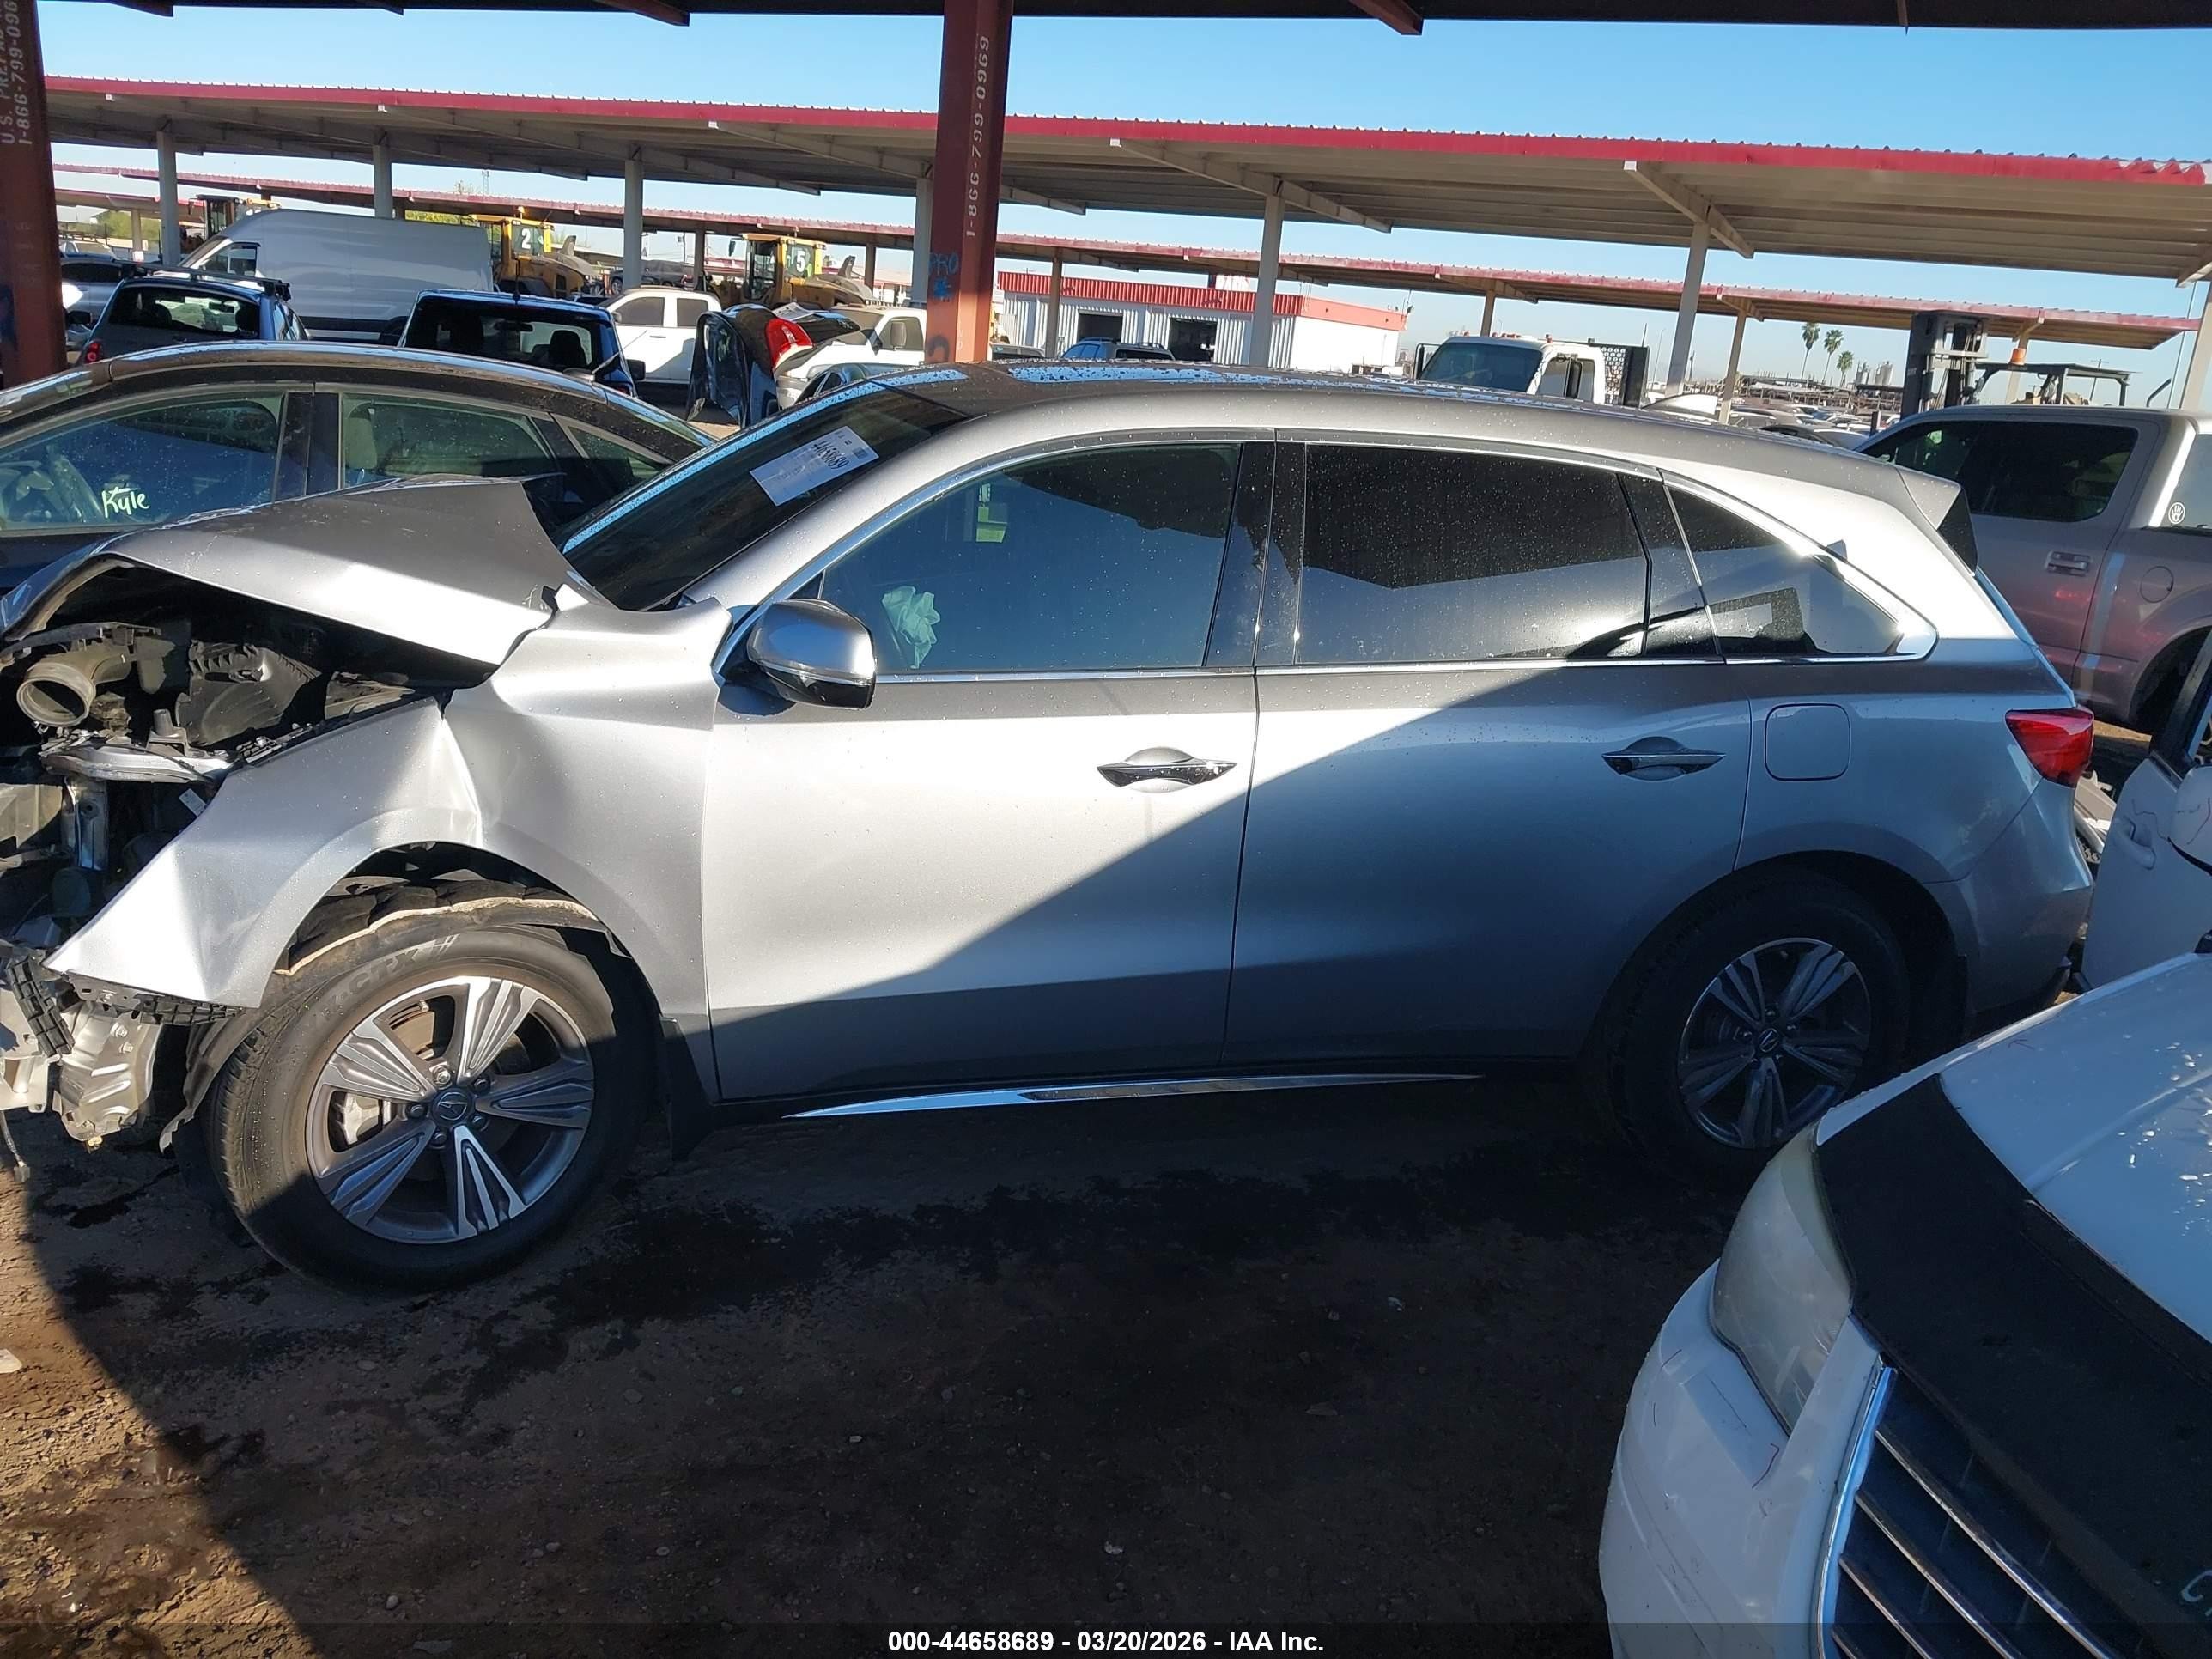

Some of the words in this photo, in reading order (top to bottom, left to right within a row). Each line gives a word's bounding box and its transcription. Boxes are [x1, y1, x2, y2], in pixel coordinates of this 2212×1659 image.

[1, 111, 15, 144] U.S.
[966, 35, 989, 237] 1-866-799-0969
[521, 228, 532, 249] 2
[796, 250, 805, 272] 5
[102, 487, 149, 518] Kyle
